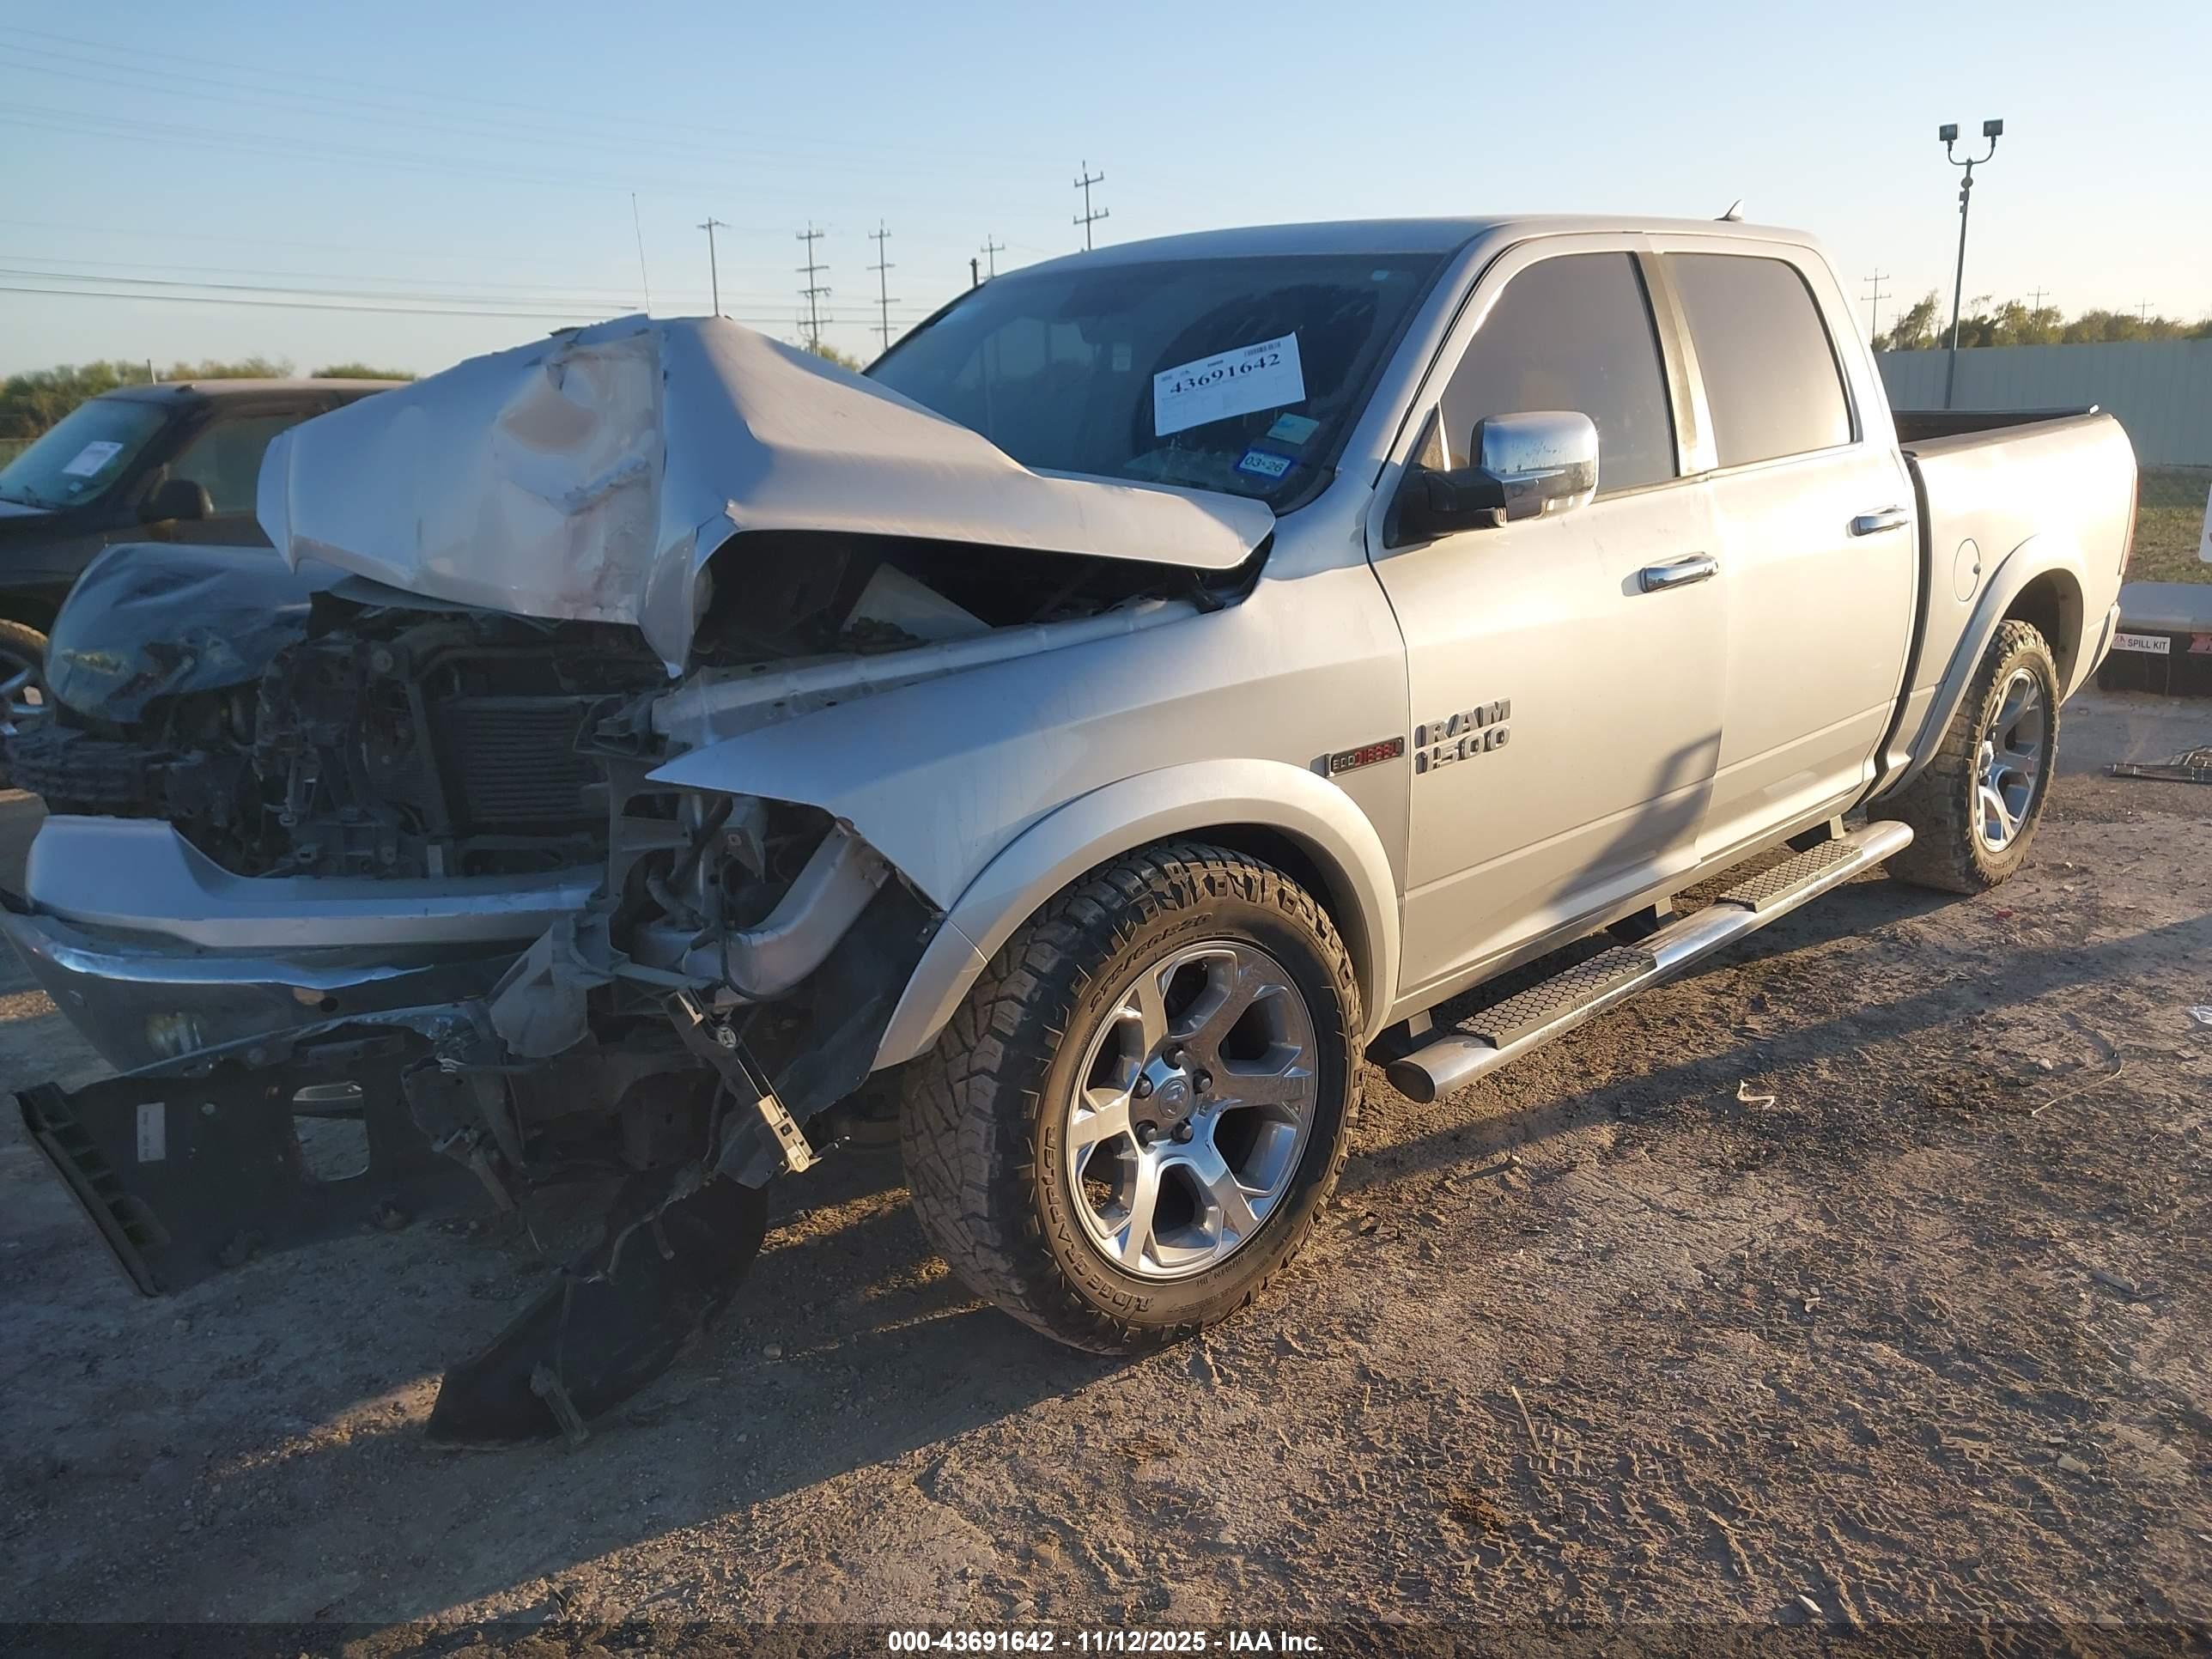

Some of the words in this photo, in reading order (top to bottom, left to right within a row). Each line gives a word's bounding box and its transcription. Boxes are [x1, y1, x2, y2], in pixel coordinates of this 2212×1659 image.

[1170, 353, 1281, 394] 43691642
[2127, 638, 2151, 649] SPILL
[2154, 641, 2168, 650] KIT
[1414, 696, 1511, 750] RAM
[1414, 725, 1511, 775] 1500
[1041, 1124, 1089, 1277] GRAPPLER
[1086, 1273, 1152, 1313] RIDGE
